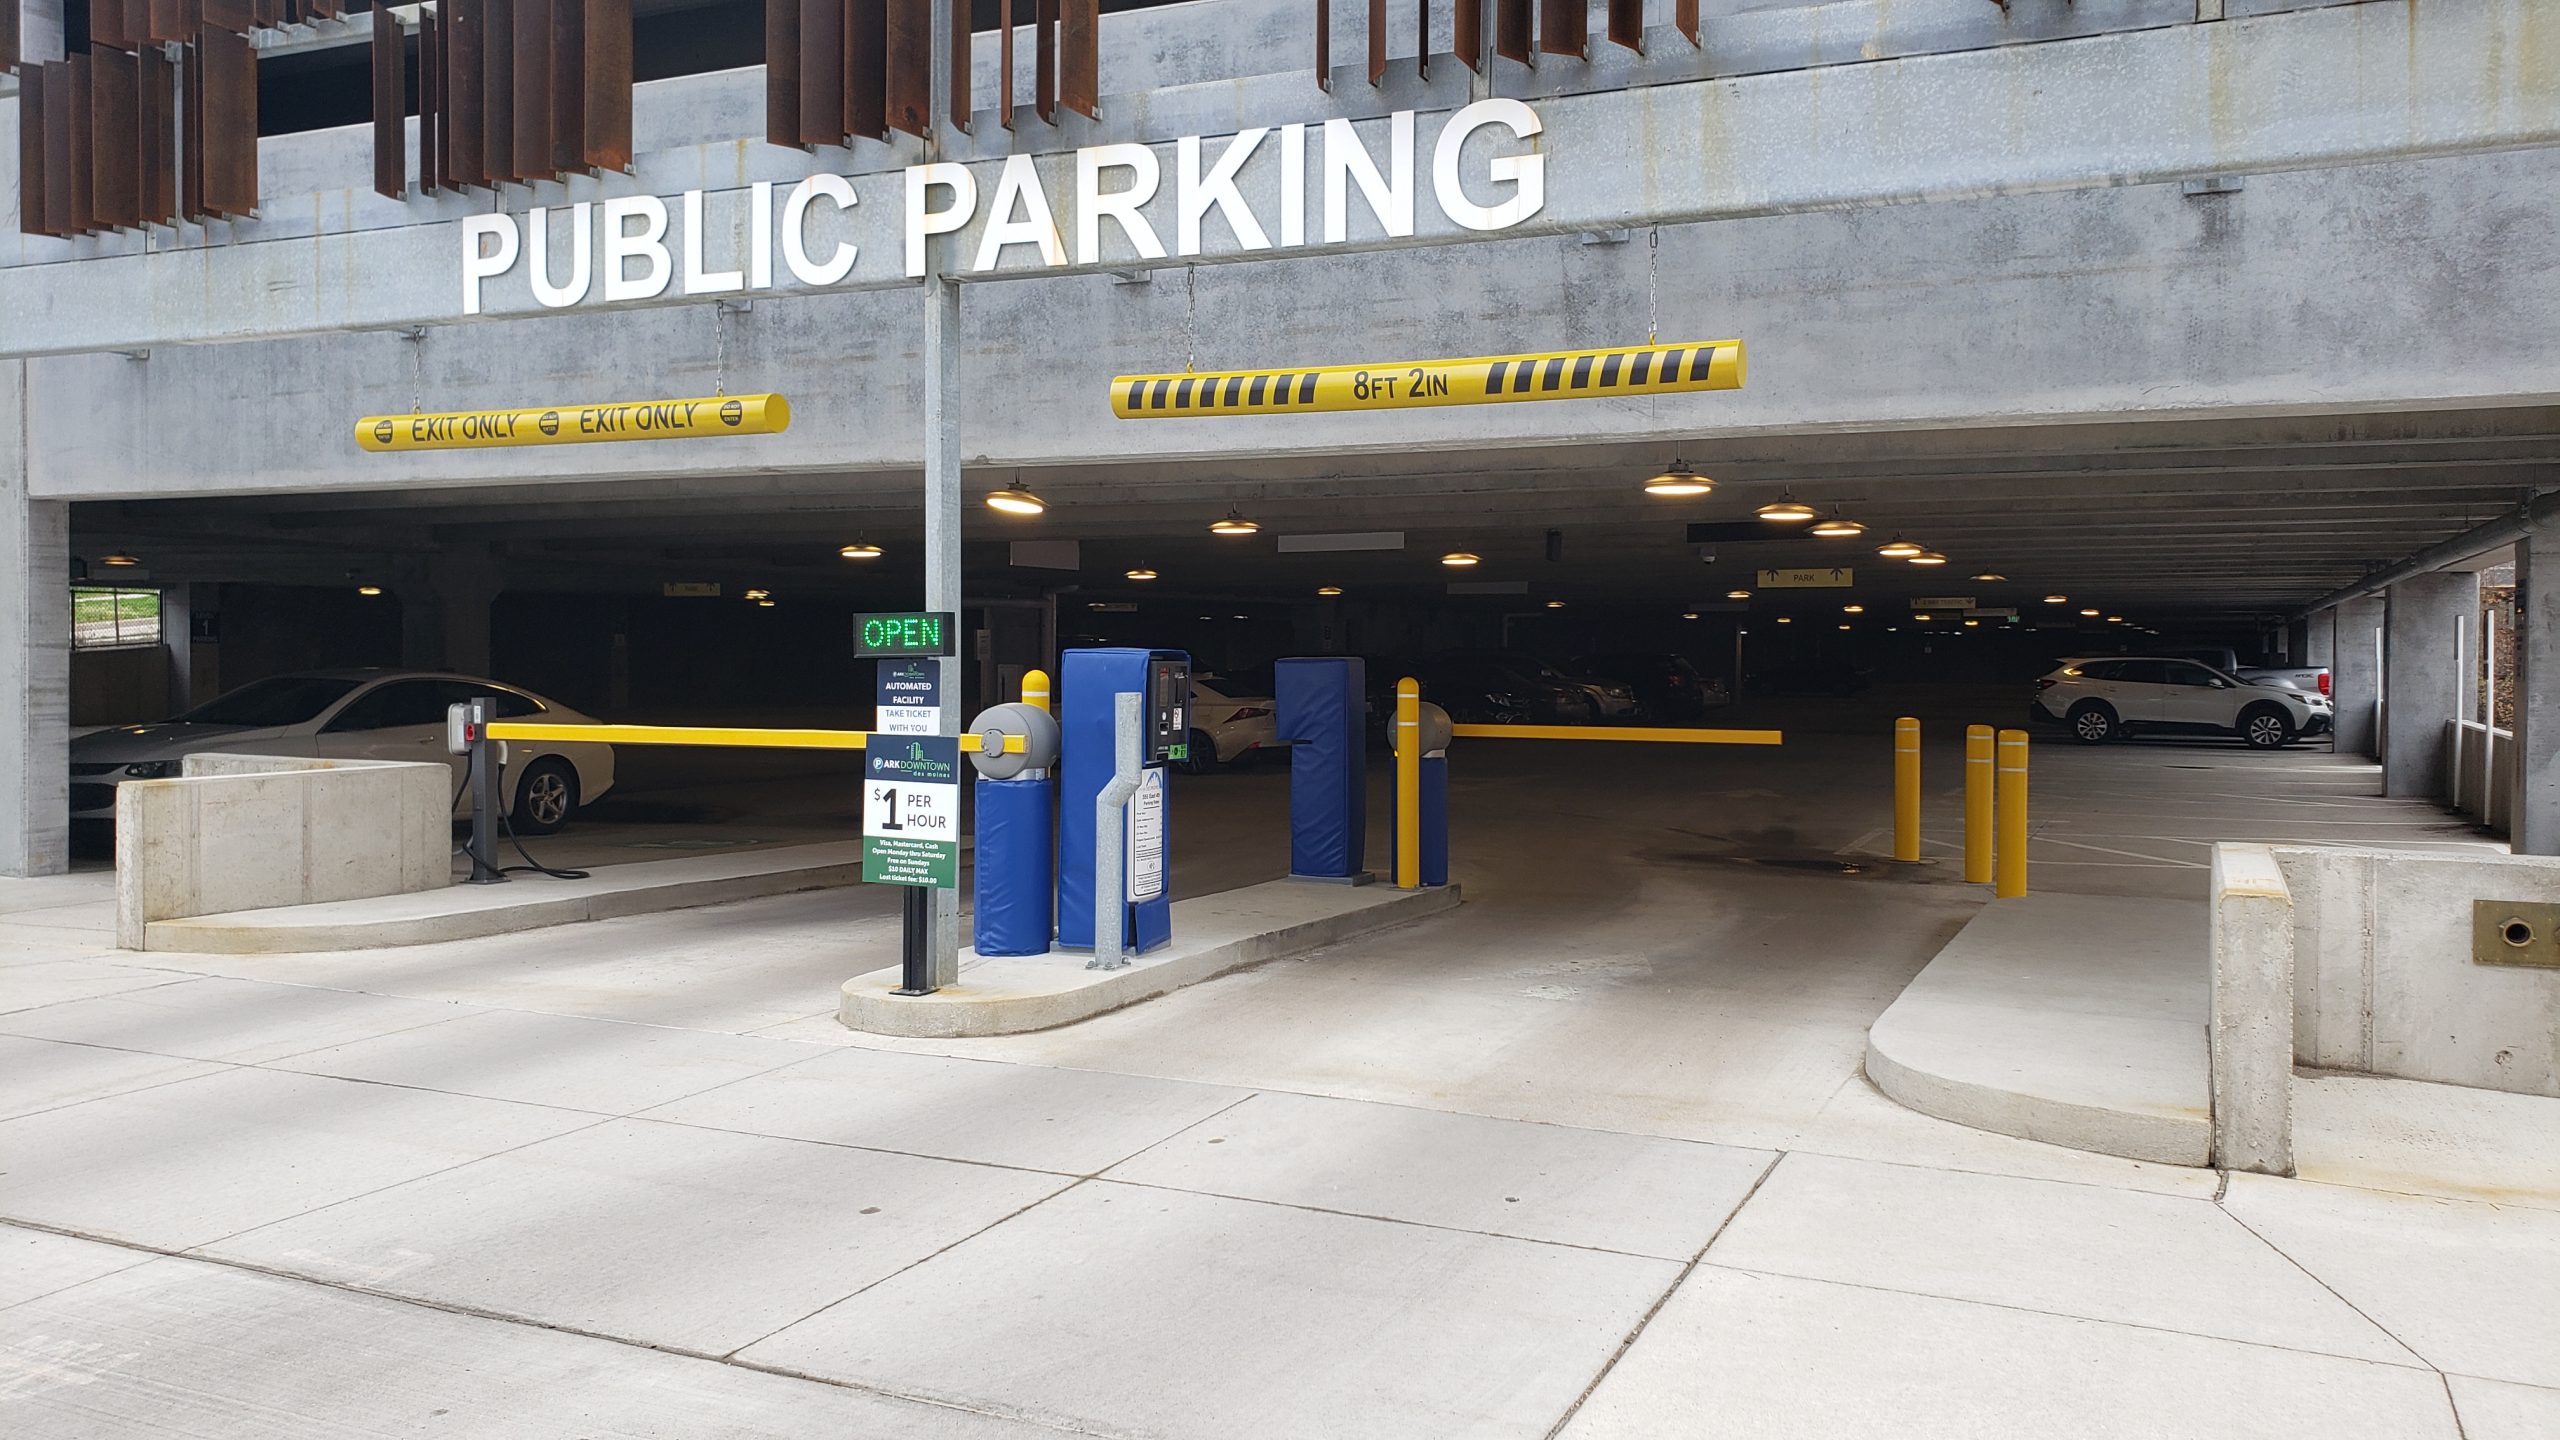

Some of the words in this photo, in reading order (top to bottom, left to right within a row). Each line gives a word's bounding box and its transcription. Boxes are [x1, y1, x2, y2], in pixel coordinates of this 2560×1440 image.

[462, 172, 859, 315] PUBLIC
[904, 97, 1545, 278] PARKING
[1353, 370, 1398, 401] 8FT
[1408, 367, 1449, 398] 2IN
[580, 406, 632, 434] EXIT
[635, 402, 701, 431] ONLY
[412, 416, 459, 443] EXIT
[462, 413, 521, 440] ONLY
[1793, 574, 1815, 582] PARK
[864, 618, 939, 647] OPEN
[885, 682, 932, 691] AUTOMATED
[892, 696, 925, 704] FACILITY
[886, 709, 905, 718] TAKE
[906, 709, 932, 718] TICKET
[889, 724, 908, 732] WITH
[910, 724, 927, 732] YOU
[907, 794, 932, 808] PER
[907, 814, 947, 829] HOUR
[925, 842, 939, 850] Cash
[872, 847, 887, 855] Open
[887, 849, 909, 857] Monday
[922, 851, 946, 860] Saturday
[908, 858, 930, 867] Sundays
[899, 865, 915, 874] DAILY
[915, 867, 929, 875] MAX
[879, 873, 891, 881] Lost
